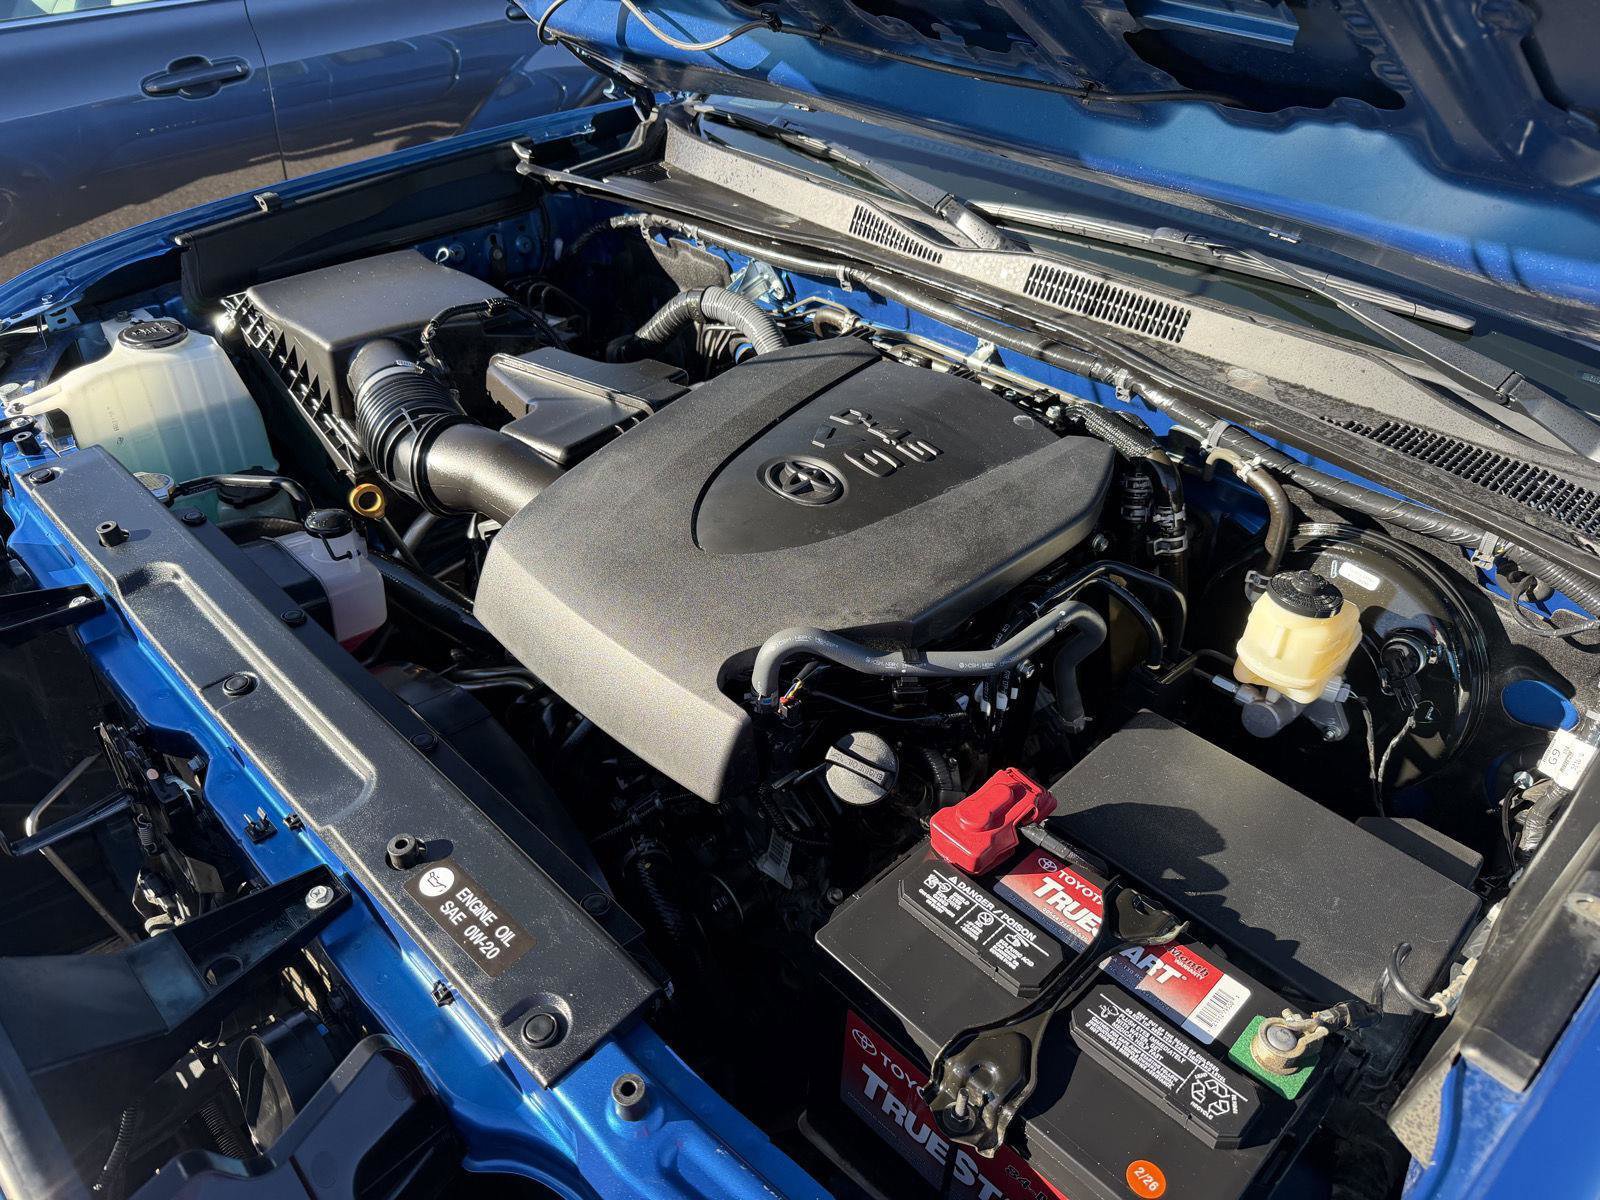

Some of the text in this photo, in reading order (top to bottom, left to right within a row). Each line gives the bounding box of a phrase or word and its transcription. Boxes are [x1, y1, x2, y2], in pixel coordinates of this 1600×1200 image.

[1548, 748, 1560, 765] G9
[1058, 870, 1103, 905] TOYOTA
[440, 900, 501, 960] SAE 0W-20
[455, 887, 516, 948] ENGINE OIL
[956, 880, 1037, 942] DANGER / POISON
[1018, 953, 1034, 967] ACID
[1173, 956, 1204, 982] WARRANTY
[1111, 1020, 1163, 1061] MEDICAL HELP FAST
[1114, 1017, 1130, 1030] WITH
[1149, 1042, 1162, 1053] GET
[1118, 1012, 1186, 1064] FLUSH EYES IMMEDIATELY
[880, 1051, 926, 1099] TOY
[1189, 1101, 1214, 1120] RECYCLE
[861, 1063, 1010, 1200] TRUEST
[1133, 1166, 1160, 1192] 2/26
